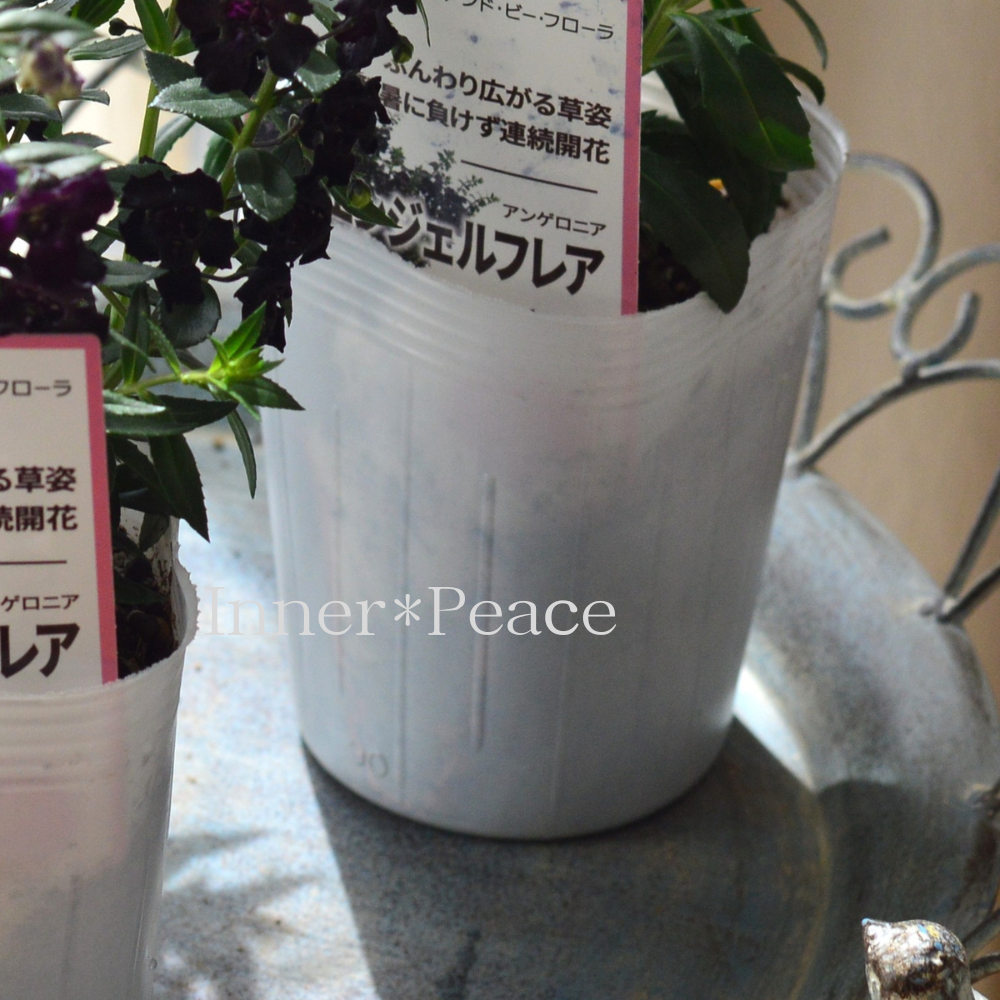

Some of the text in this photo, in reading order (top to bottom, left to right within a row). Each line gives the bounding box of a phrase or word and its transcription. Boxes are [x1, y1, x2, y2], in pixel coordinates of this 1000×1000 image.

[379, 83, 610, 165] 暑に負けず連続開花
[331, 196, 605, 296] ジェルフレア
[503, 203, 607, 236] アンゲロニア
